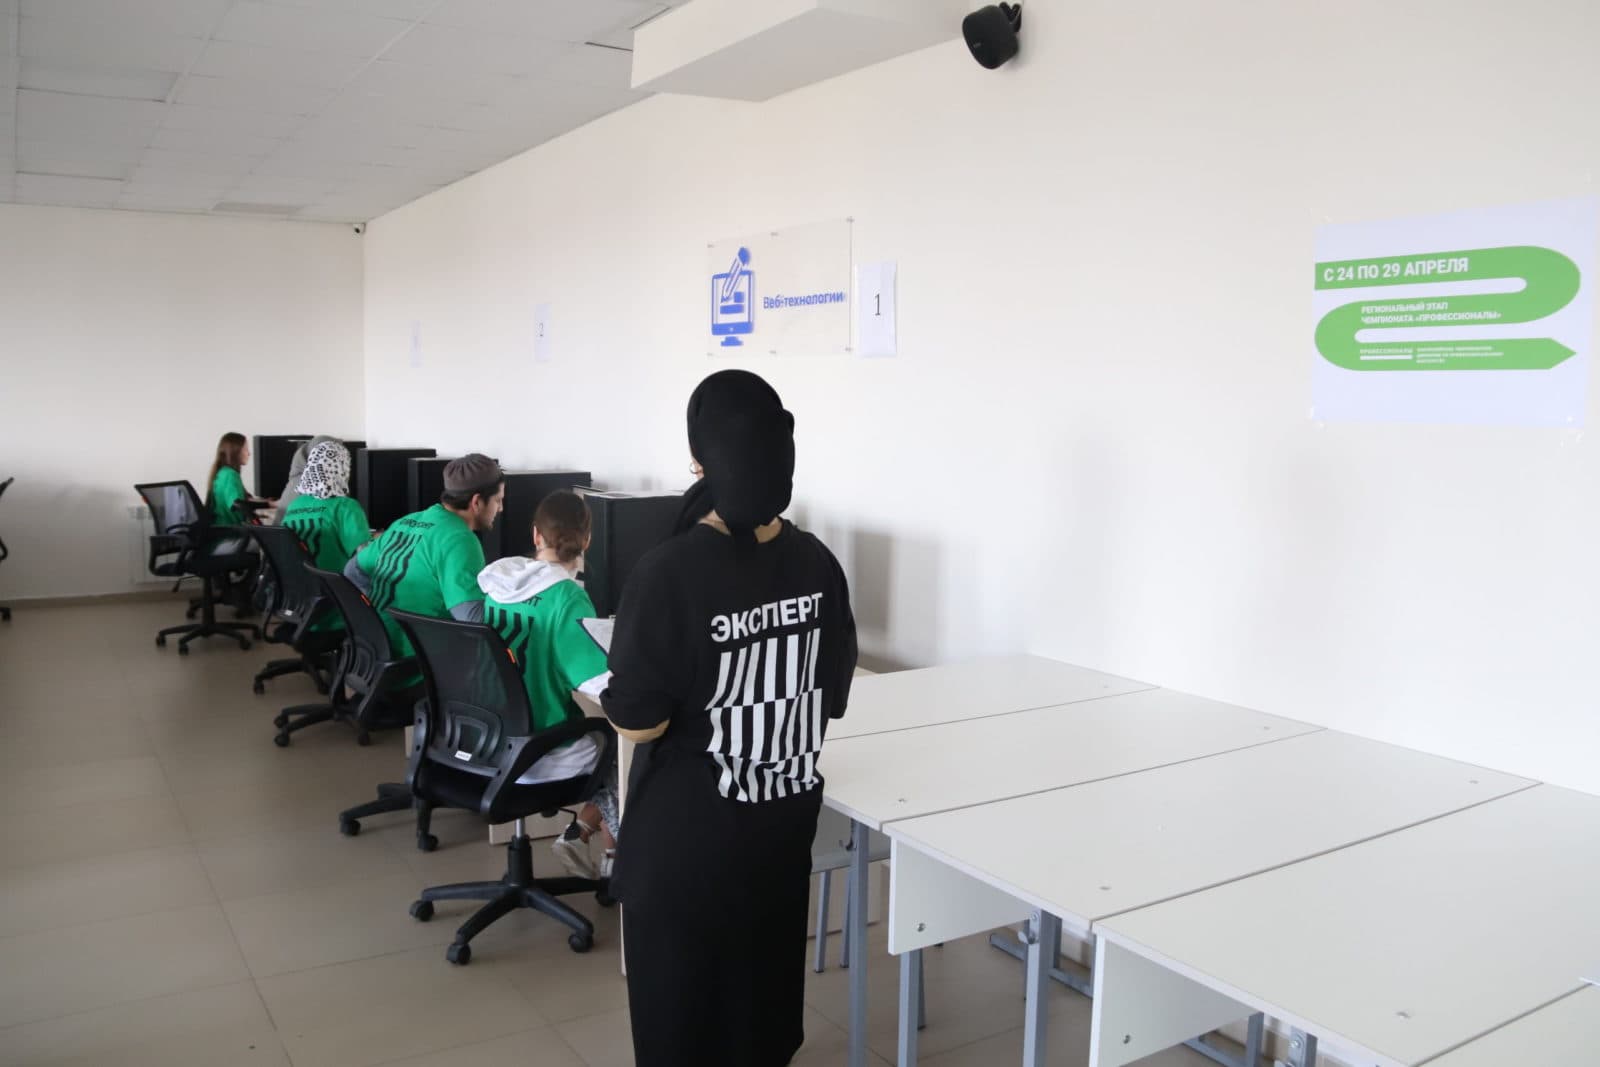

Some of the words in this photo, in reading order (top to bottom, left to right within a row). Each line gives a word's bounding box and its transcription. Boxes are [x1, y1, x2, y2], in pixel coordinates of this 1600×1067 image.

[1324, 268, 1334, 282] С
[1337, 266, 1354, 281] 24
[1357, 265, 1379, 280] ПО
[1382, 263, 1400, 278] 29
[1403, 257, 1469, 277] АПРЕЛЯ
[763, 291, 844, 310] Веб-технологии
[874, 293, 881, 316] 1
[1361, 302, 1425, 314] РЕГИОНАЛЬНЫЙ
[1426, 302, 1448, 312] ЭТАП
[711, 592, 823, 642] ЭКСПЕРТ
